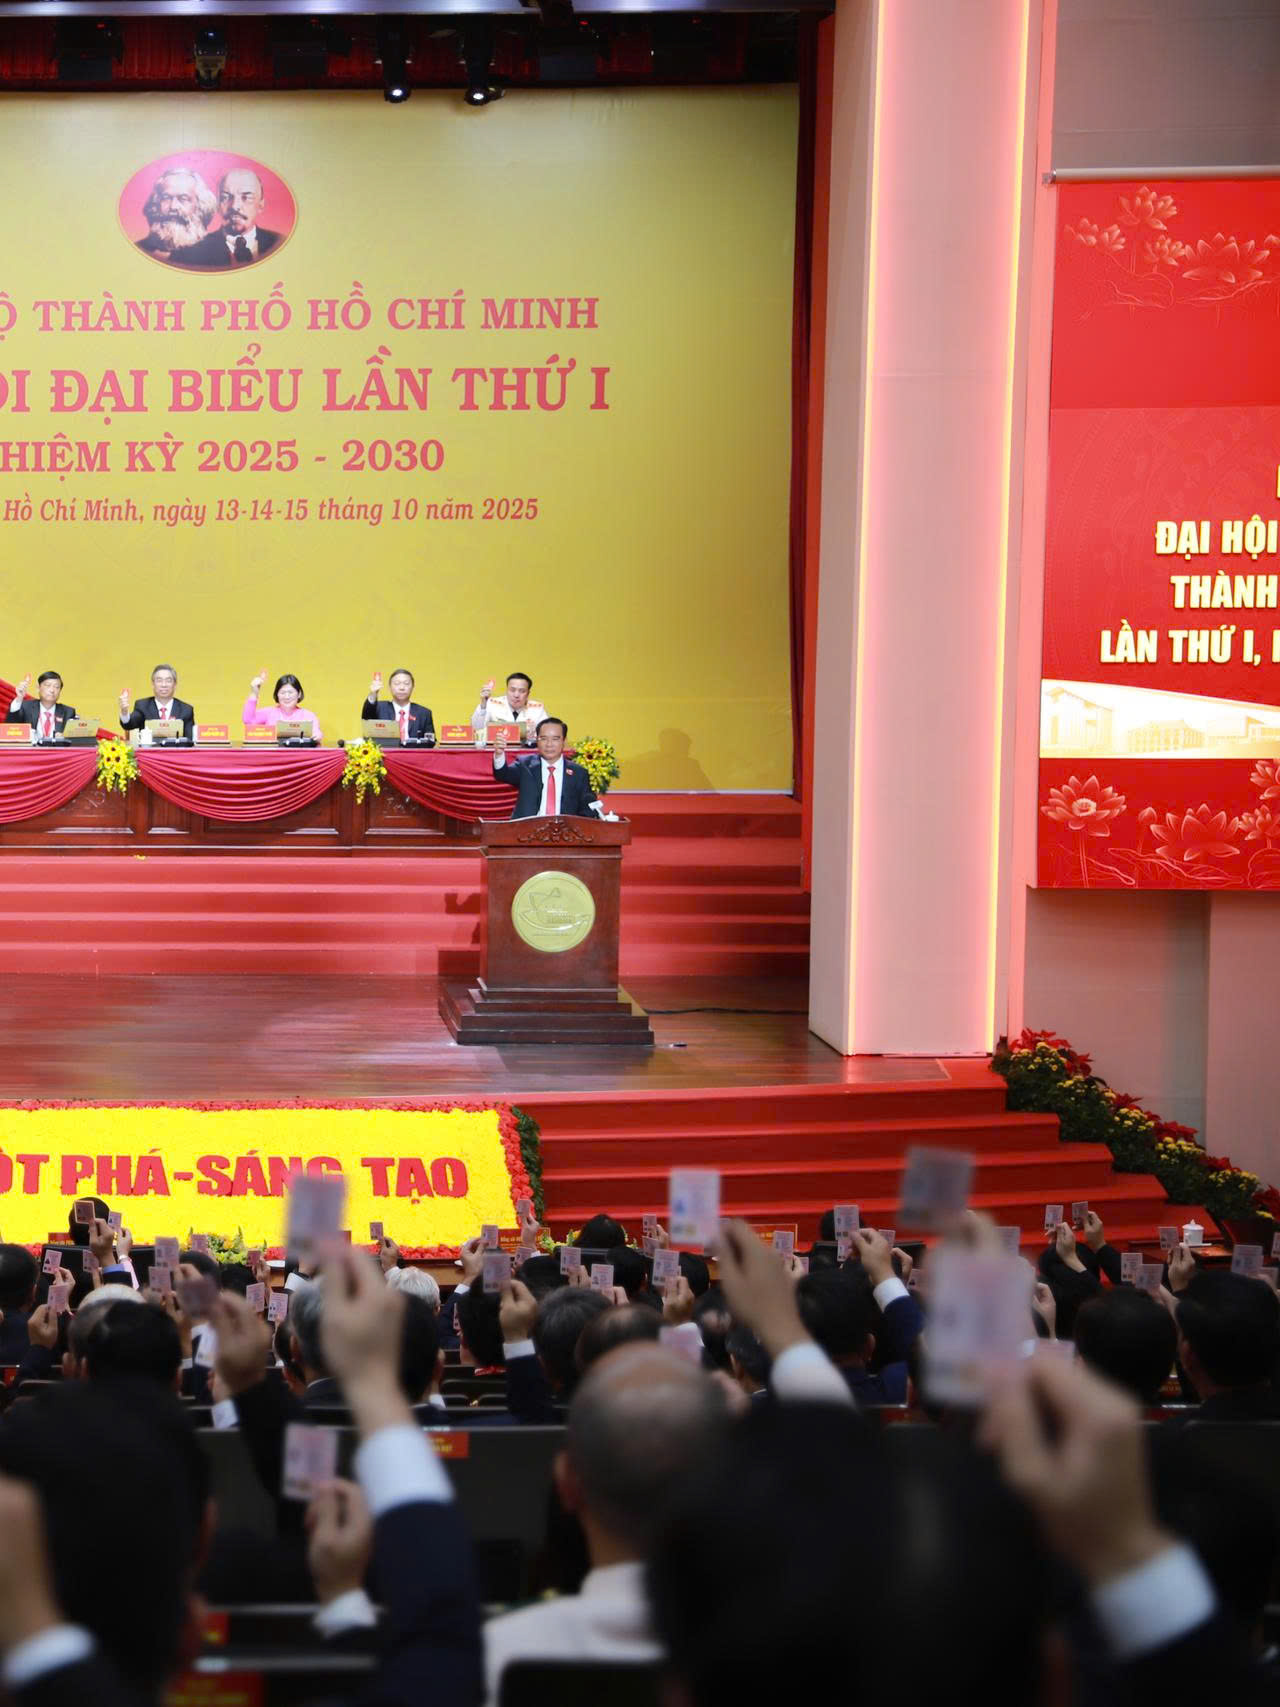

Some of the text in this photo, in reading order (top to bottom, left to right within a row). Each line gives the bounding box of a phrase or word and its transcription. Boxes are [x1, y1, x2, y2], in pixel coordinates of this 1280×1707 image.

[33, 292, 185, 333] THÀNH
[201, 282, 293, 332] PHỐ
[308, 281, 373, 331] HỒ
[388, 291, 466, 332] CHÍ
[482, 298, 599, 331] MINH
[51, 369, 150, 425] ĐẠI
[169, 343, 305, 413] BIỂU
[322, 346, 433, 413] LẦN
[451, 355, 577, 412] THỨ
[591, 368, 612, 412] I
[125, 432, 185, 474] KỲ
[198, 440, 300, 474] 2025
[342, 439, 446, 474] 2030
[4, 494, 34, 522] Hồ
[40, 499, 77, 522] Chí
[84, 499, 146, 526] Minh,
[154, 499, 208, 529] ngày
[216, 500, 311, 522] 13-14-15
[320, 498, 384, 528] tháng
[392, 499, 420, 522] 10
[427, 500, 474, 522] năm
[482, 499, 540, 522] 2025
[1155, 514, 1278, 560] ĐẠI HỘI
[1170, 570, 1278, 609] THÀNH
[1101, 619, 1158, 663] LẦN
[1169, 624, 1236, 664] THỨ
[1243, 630, 1261, 666] I,
[361, 1157, 470, 1204] TẠO
